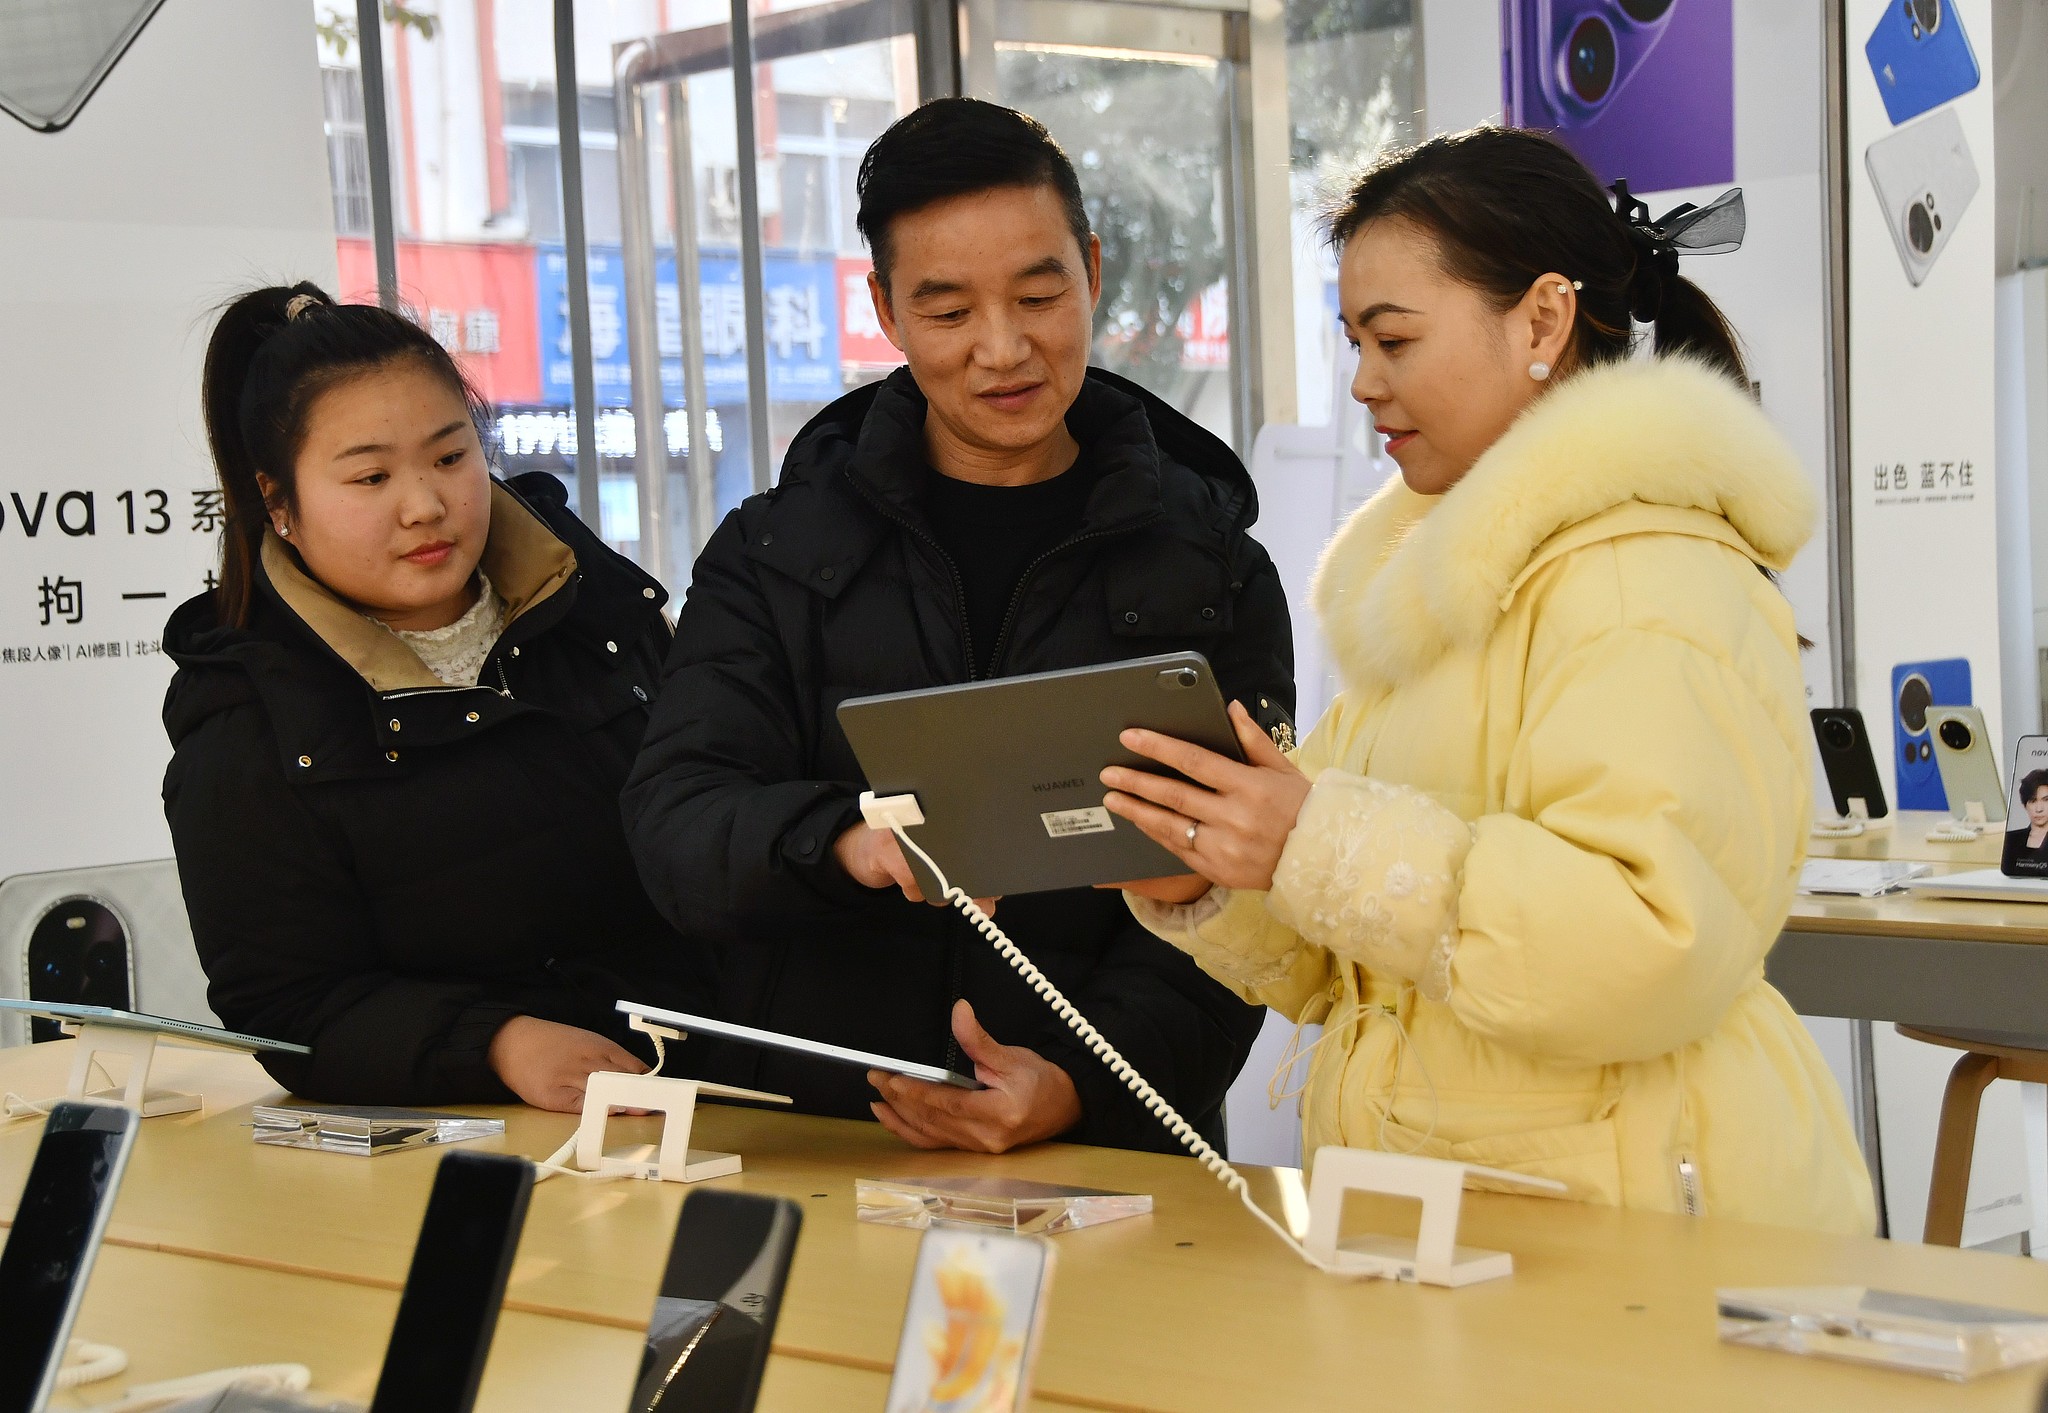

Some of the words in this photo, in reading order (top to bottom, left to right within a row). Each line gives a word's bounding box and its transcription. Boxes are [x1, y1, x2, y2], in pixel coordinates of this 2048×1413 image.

[1874, 463, 1908, 490] 出色
[1921, 460, 1974, 488] 蓝不住
[0, 490, 96, 537] va
[116, 489, 171, 535] 13
[2031, 749, 2048, 757] nov
[1032, 778, 1085, 793] HUAWEI
